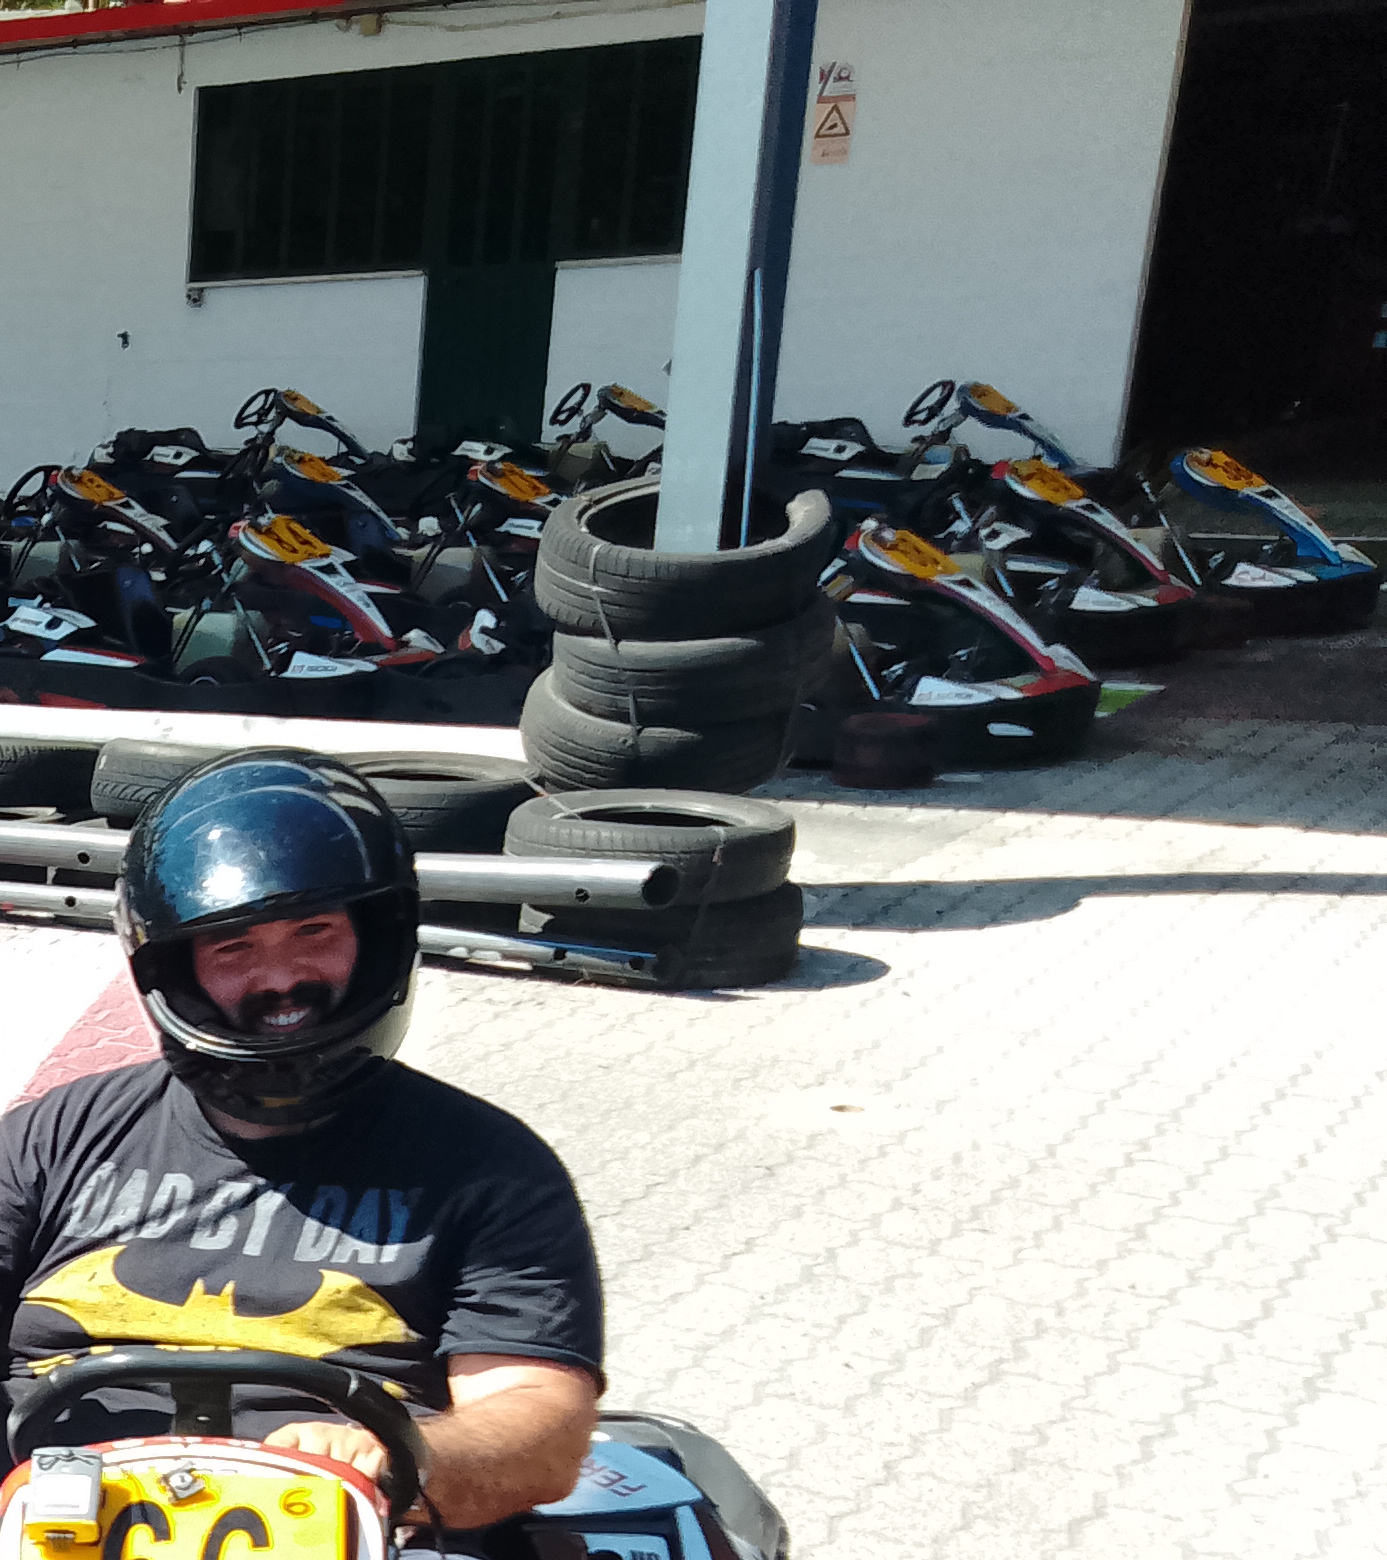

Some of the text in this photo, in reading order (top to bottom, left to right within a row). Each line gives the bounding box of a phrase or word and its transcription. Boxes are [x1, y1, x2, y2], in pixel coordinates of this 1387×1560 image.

[62, 1161, 424, 1264] DAD BY DAY
[281, 1491, 314, 1518] 6
